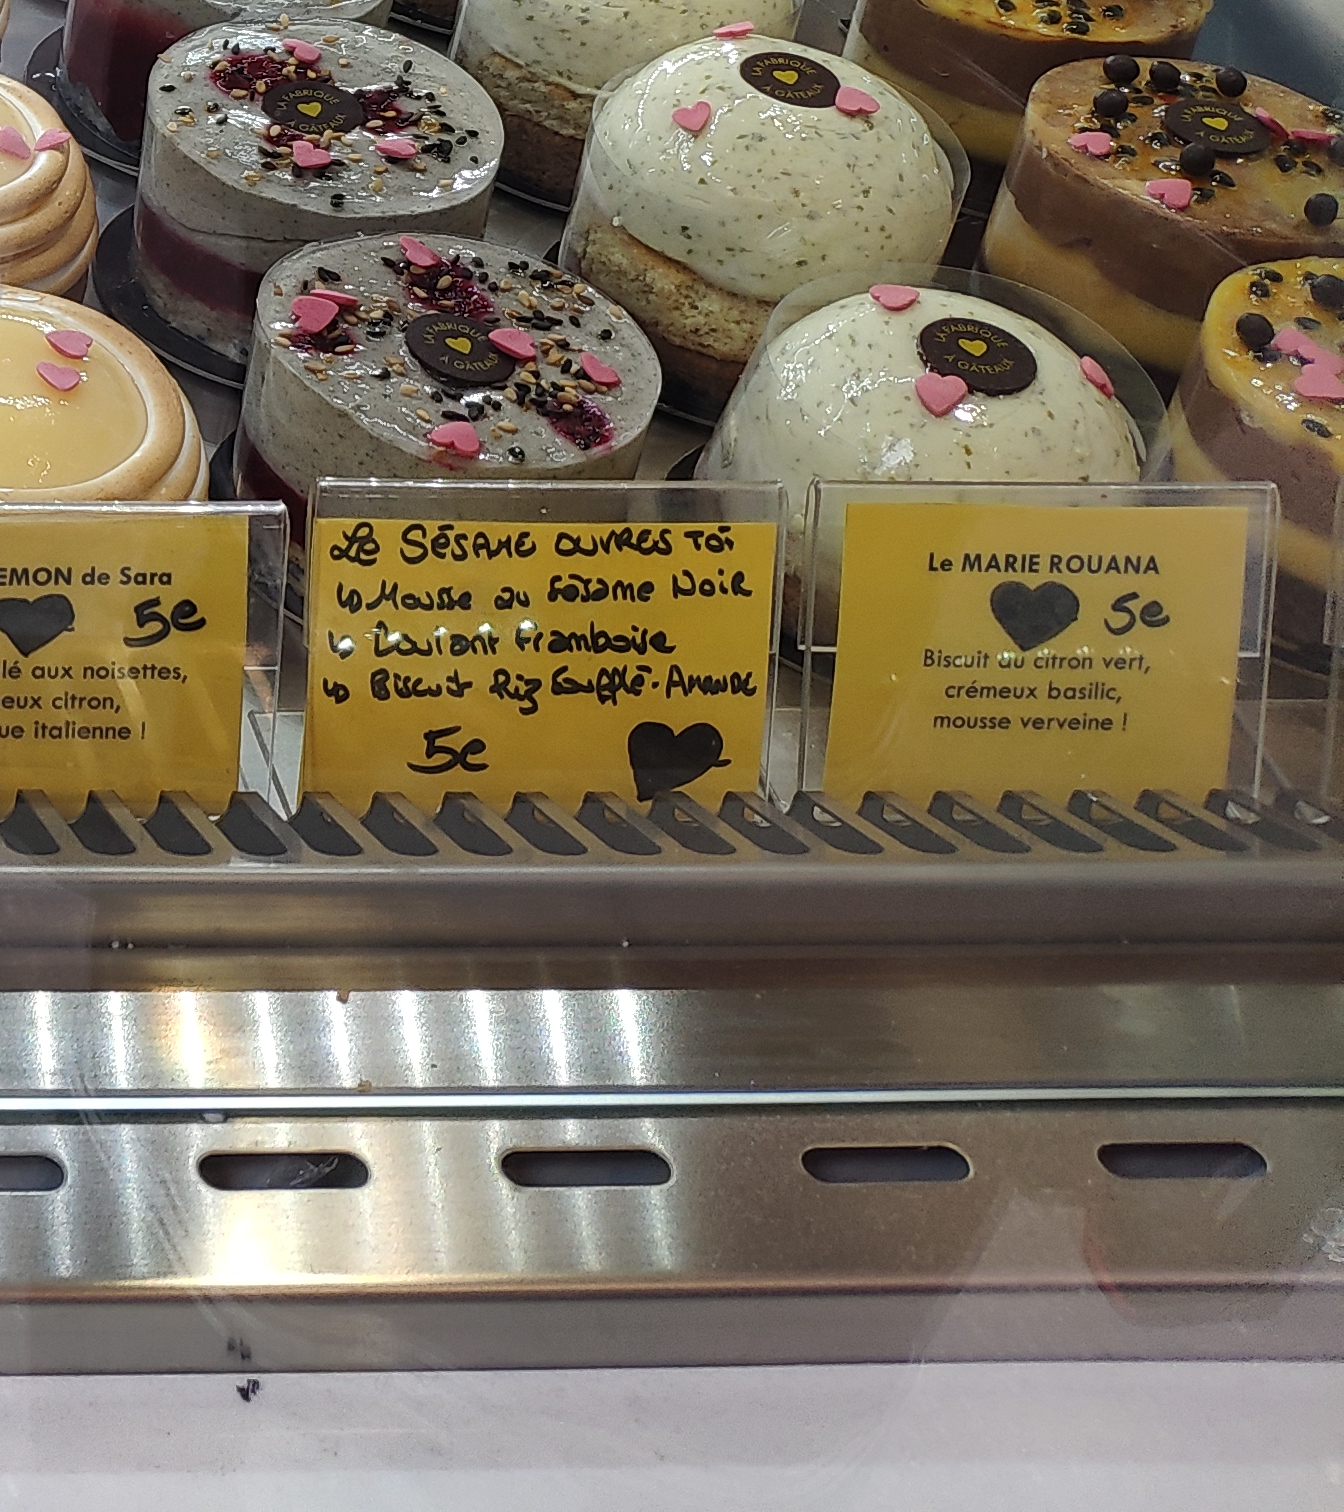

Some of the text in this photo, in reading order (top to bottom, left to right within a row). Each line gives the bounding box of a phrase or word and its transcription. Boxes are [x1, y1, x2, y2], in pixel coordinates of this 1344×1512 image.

[751, 57, 817, 77] LA FABRIQUE
[276, 88, 341, 111] LA FABRIQUE
[421, 321, 487, 345] LA FABRIQUE
[934, 322, 1010, 350] LA FABRIQUE
[956, 358, 1016, 376] GÂTEAUX
[927, 552, 1161, 575] Le MARIE ROUANA
[80, 566, 111, 586] de
[119, 567, 173, 586] Sara
[31, 663, 74, 680] aux
[82, 661, 188, 685] noisettes,
[922, 648, 990, 669] Biscuit
[1033, 650, 1093, 670] citron
[1102, 653, 1152, 675] vert,
[51, 691, 121, 715] citron,
[944, 680, 1123, 704] crémeux basilic,
[33, 720, 132, 740] italienne
[933, 712, 1011, 730] mousse
[1020, 712, 1114, 731] verveine
